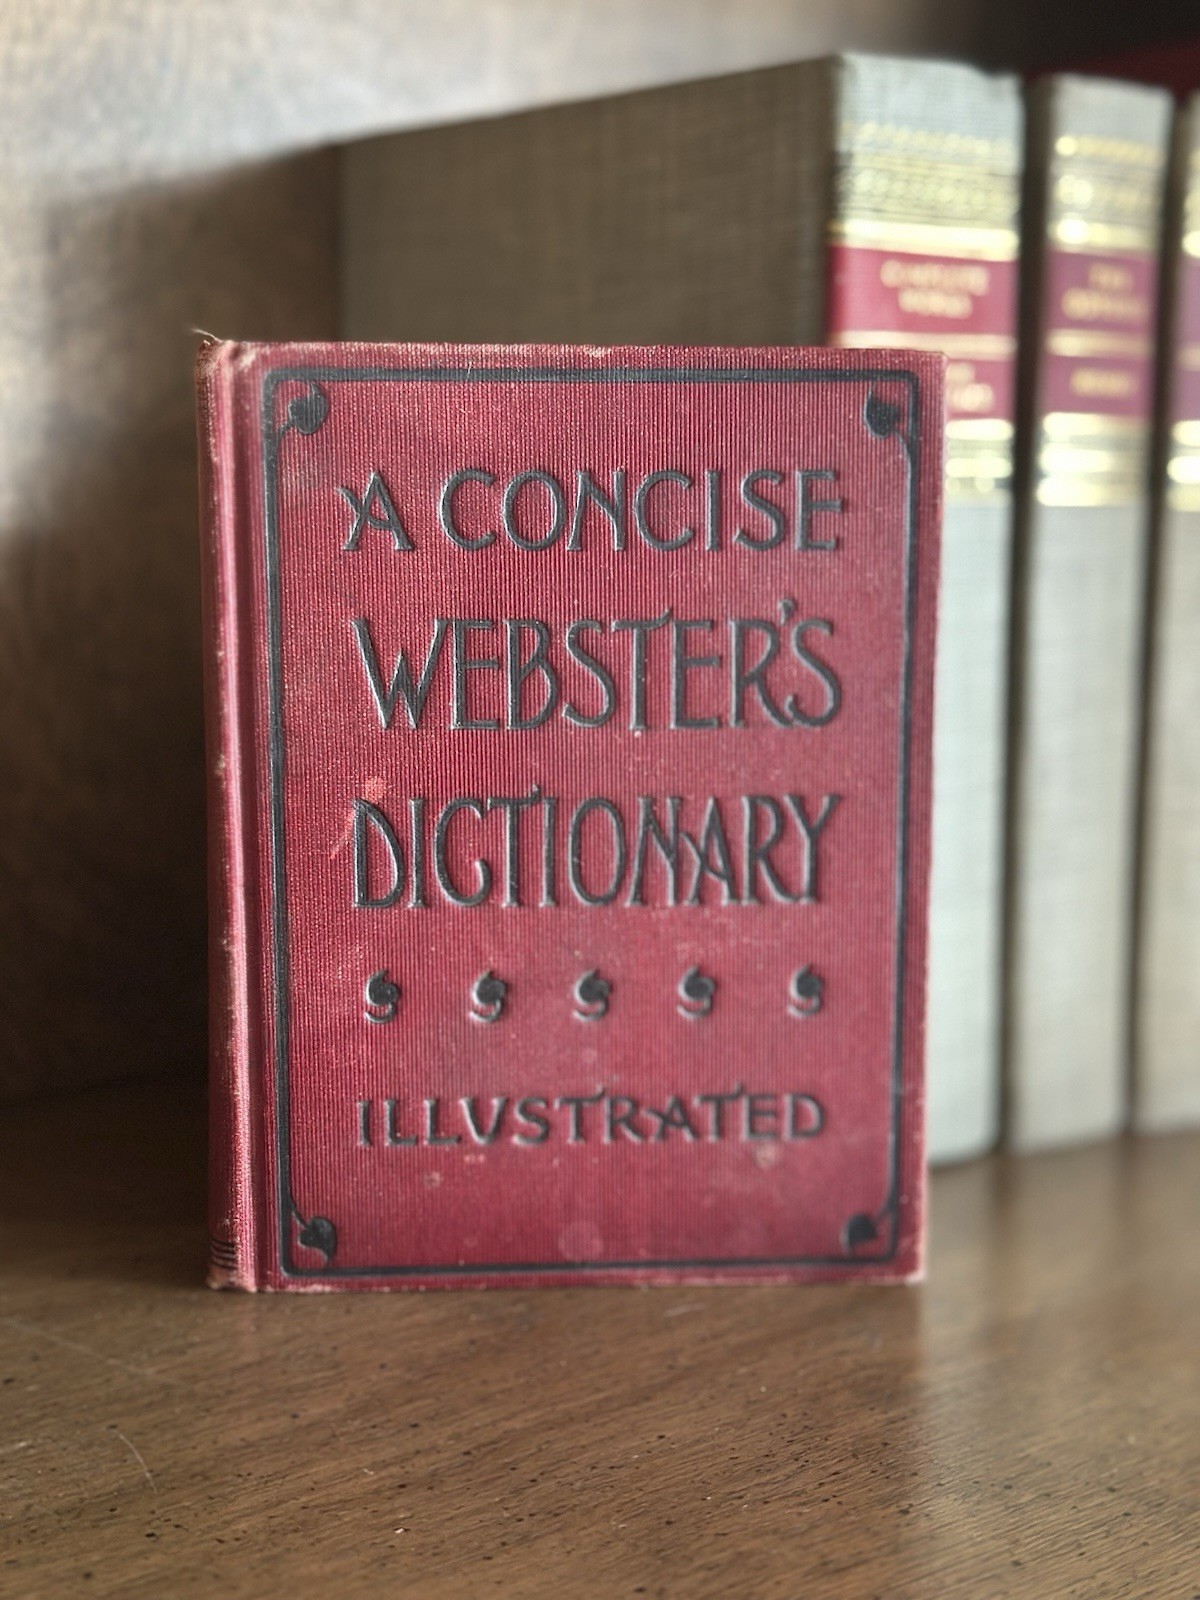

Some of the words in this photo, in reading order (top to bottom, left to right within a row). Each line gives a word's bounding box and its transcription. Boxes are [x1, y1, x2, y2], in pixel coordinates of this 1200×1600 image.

[337, 469, 414, 552] A
[438, 468, 844, 552] CONCISE
[350, 599, 843, 730] WEBSTER'S
[353, 785, 842, 908] DICTIONARY
